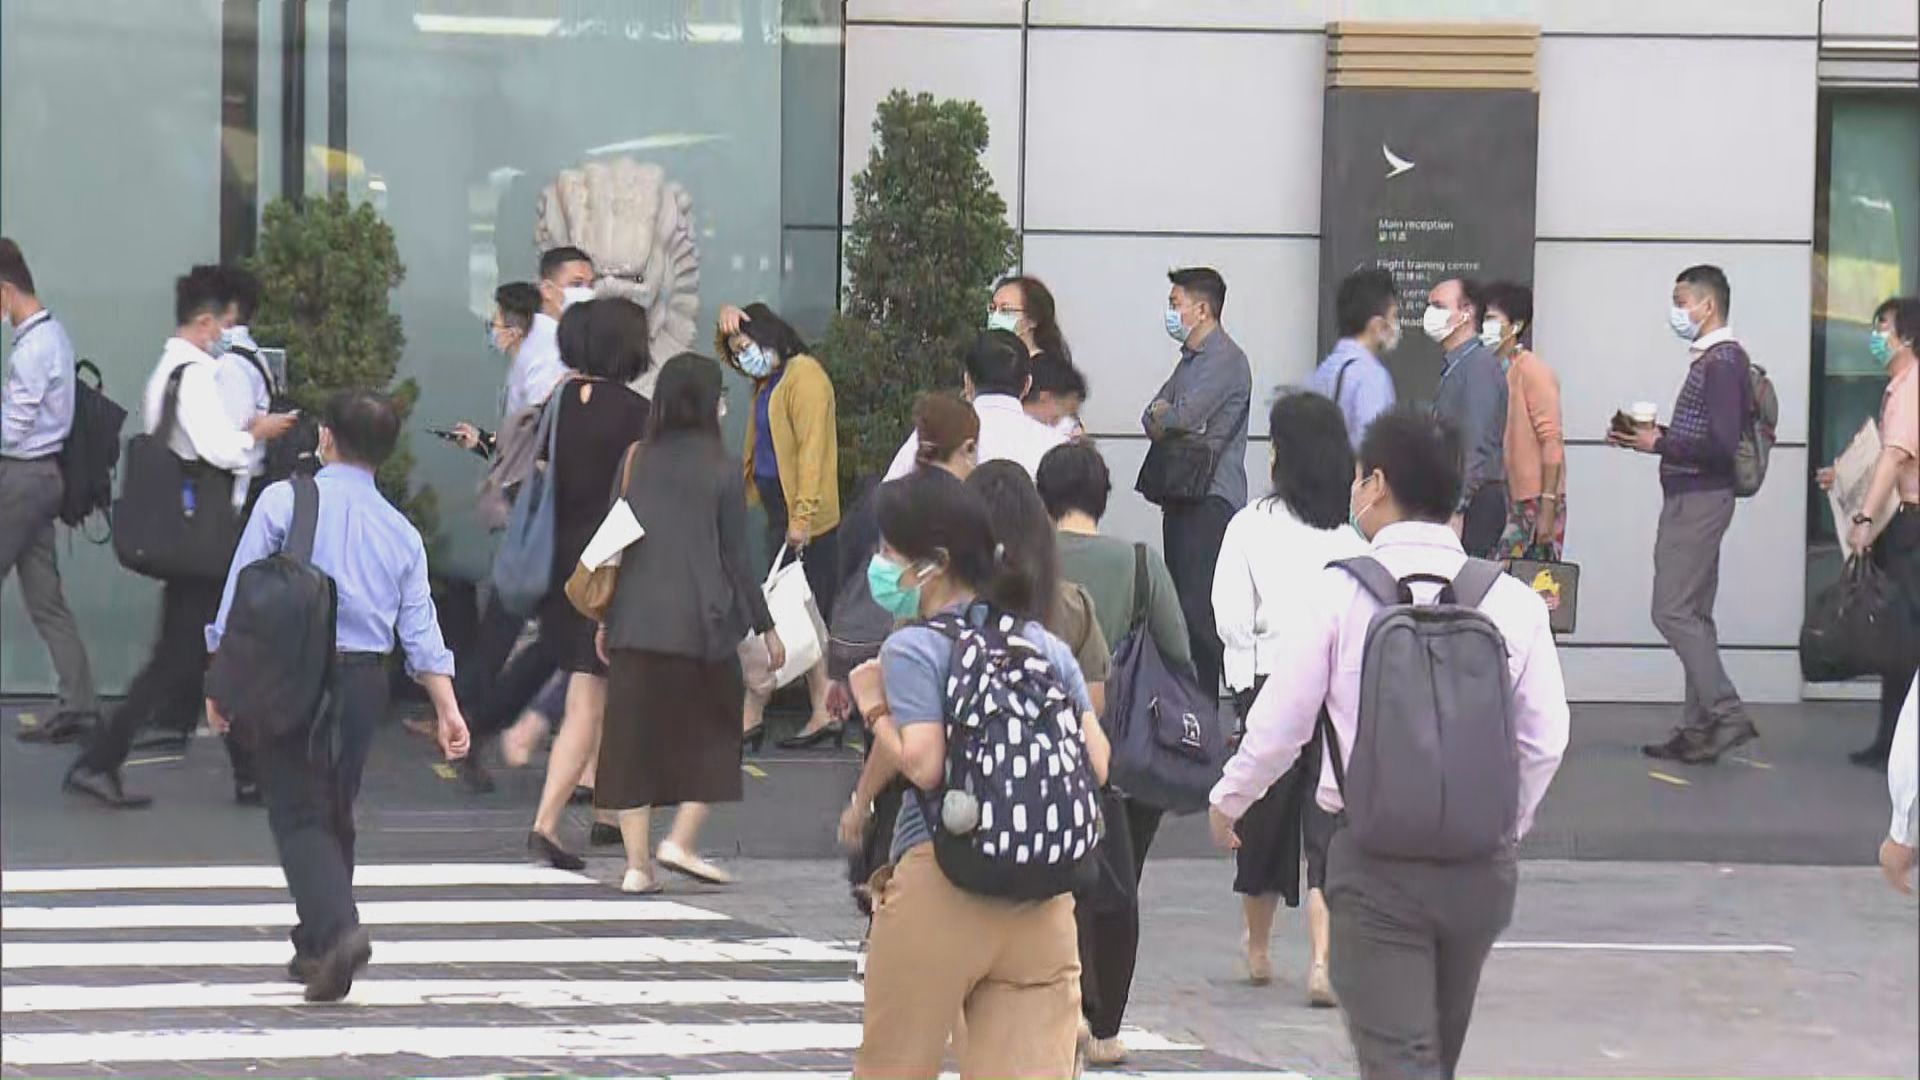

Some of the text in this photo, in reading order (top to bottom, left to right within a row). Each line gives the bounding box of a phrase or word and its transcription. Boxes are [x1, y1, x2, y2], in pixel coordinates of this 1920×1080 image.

[1378, 218, 1454, 232] Main reception
[1376, 259, 1481, 272] Flight training centre
